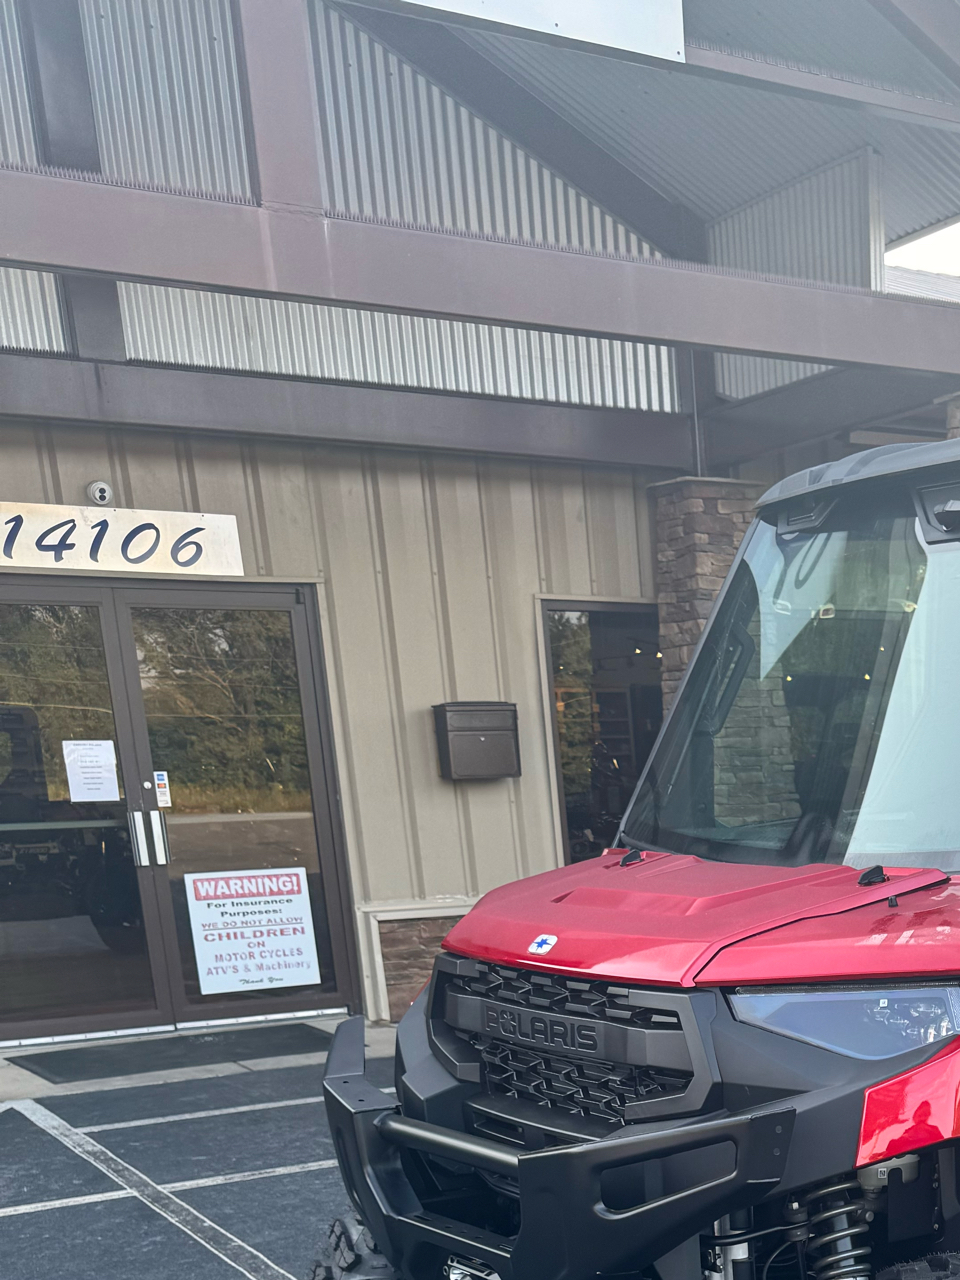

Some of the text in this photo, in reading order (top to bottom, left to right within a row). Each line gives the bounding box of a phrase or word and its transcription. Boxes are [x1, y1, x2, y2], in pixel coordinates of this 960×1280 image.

[3, 514, 206, 567] 14106
[197, 876, 299, 896] WARNING!
[231, 898, 293, 908] Insurance
[220, 908, 283, 918] Purposes:
[266, 916, 303, 924] ALLOW
[203, 926, 305, 942] CHILDREN
[247, 941, 266, 949] ON
[215, 948, 303, 963] MOTOR CYCLES
[206, 960, 311, 976] ATV'S & Machinery
[485, 1006, 598, 1052] POLARIS
